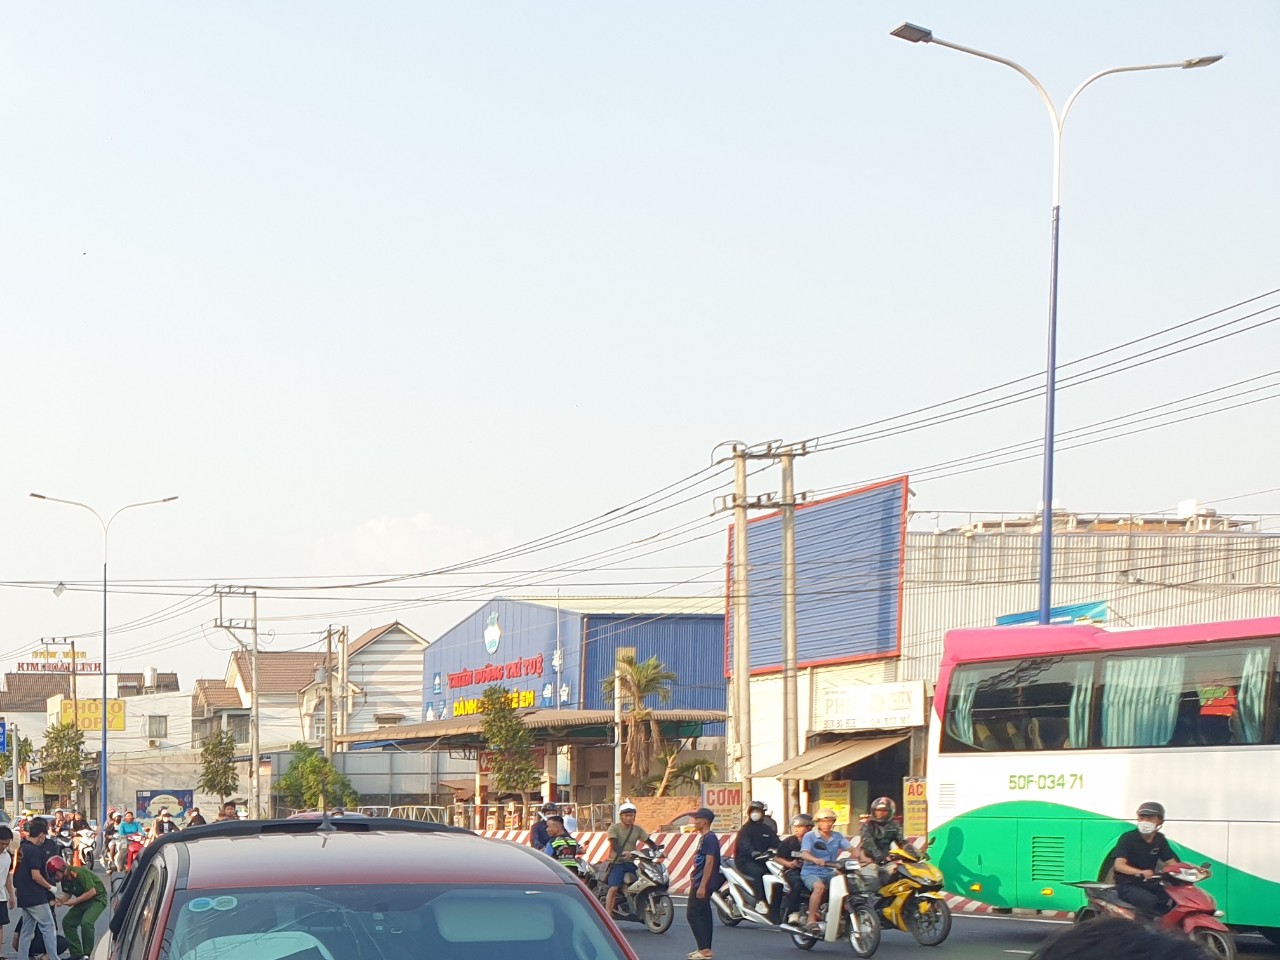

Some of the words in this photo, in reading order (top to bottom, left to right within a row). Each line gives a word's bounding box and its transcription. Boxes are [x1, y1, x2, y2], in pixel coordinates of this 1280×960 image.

[17, 662, 39, 671] KIM
[520, 690, 536, 708] EM
[706, 787, 741, 806] CƠM
